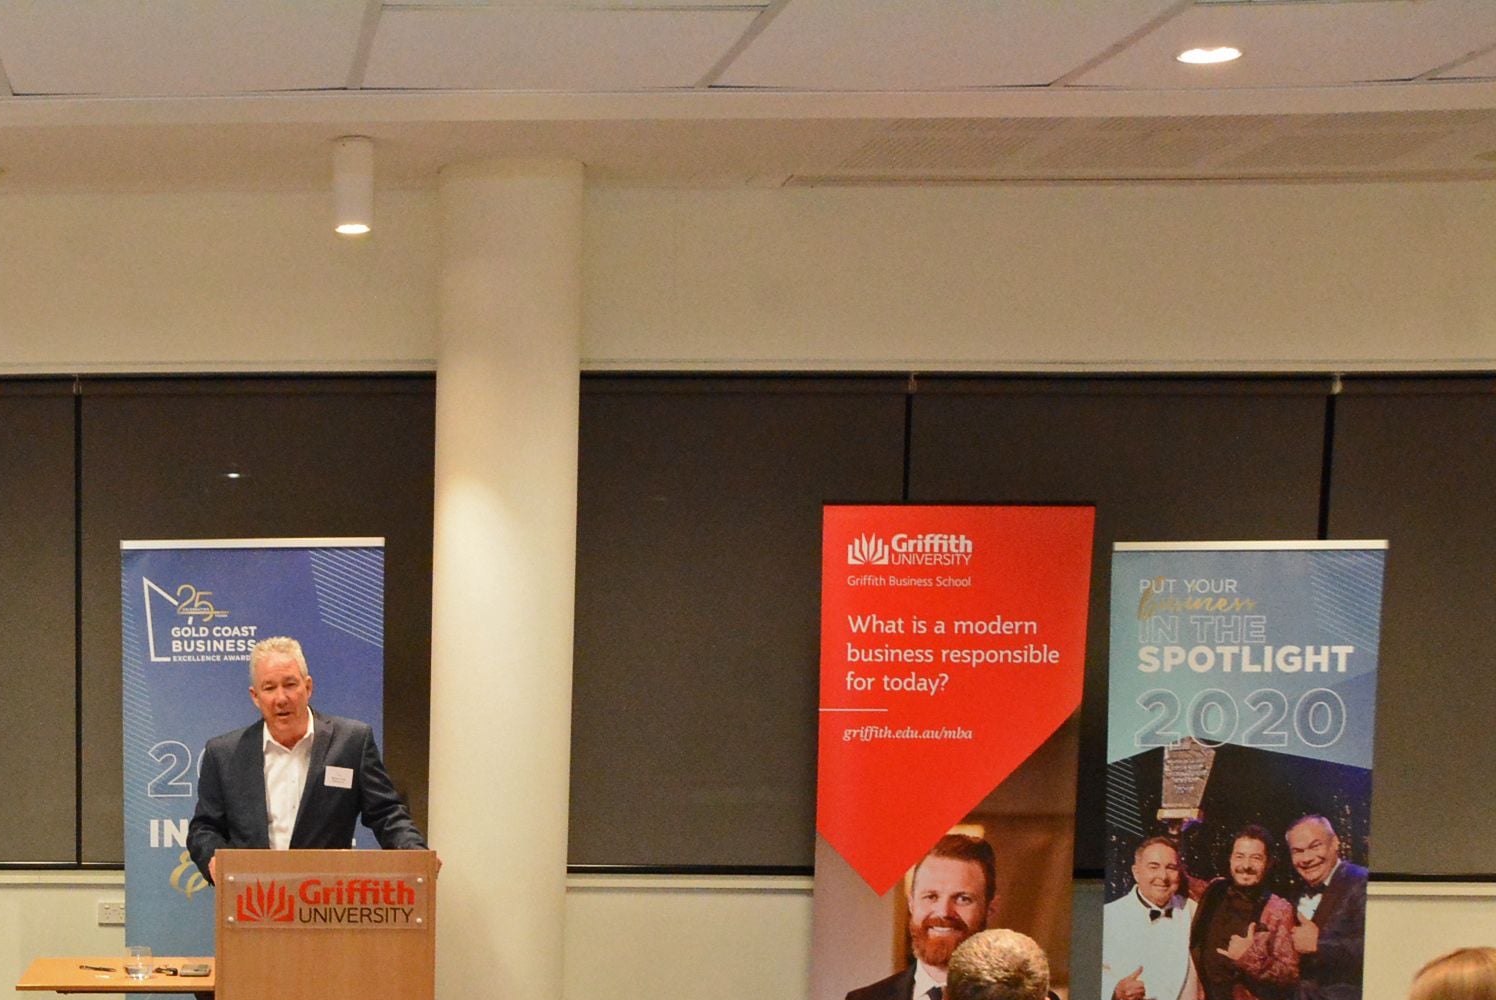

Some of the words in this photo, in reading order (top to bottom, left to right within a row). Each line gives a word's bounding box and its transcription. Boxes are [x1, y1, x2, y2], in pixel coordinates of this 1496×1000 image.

[892, 533, 972, 553] Griffith
[891, 554, 972, 566] UNIVERSITY
[847, 576, 886, 587] Griffith
[889, 576, 933, 587] Business
[936, 576, 971, 587] School
[1140, 579, 1177, 593] PUT
[1184, 579, 1238, 593] YOUR
[171, 627, 209, 637] GOLD
[212, 626, 257, 637] COAST
[848, 615, 904, 634] What
[912, 615, 927, 634] is
[935, 621, 946, 634] a
[954, 615, 1037, 635] modern
[1139, 615, 1179, 643] IN
[1190, 615, 1267, 643] THE
[172, 639, 257, 652] BUSINESS
[847, 643, 933, 663] business
[941, 643, 1060, 668] responsible
[1137, 645, 1354, 673] SPOTLIGHT
[846, 673, 876, 691] for
[883, 673, 949, 696] today?
[1134, 687, 1347, 748] 2020
[843, 725, 973, 741] griffith.edu.au/mba
[299, 879, 415, 906] Griffith
[299, 907, 415, 924] UNIVERSITY
